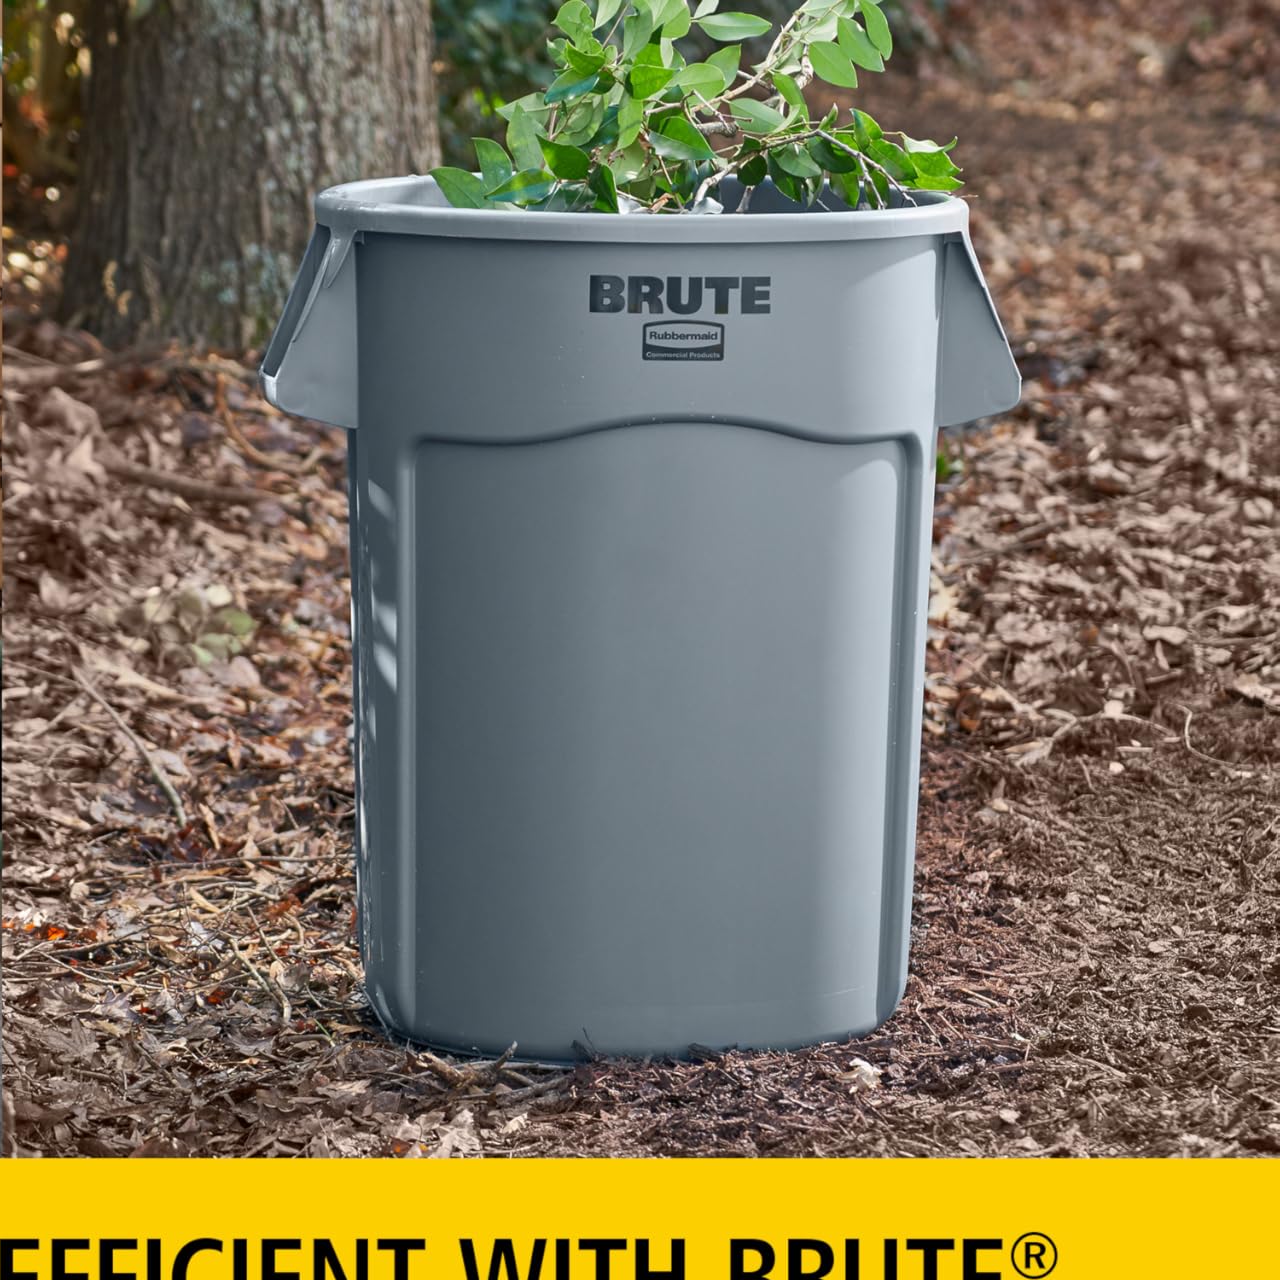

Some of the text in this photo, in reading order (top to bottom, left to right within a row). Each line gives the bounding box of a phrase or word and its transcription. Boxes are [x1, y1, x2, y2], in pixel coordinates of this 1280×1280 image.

[589, 274, 771, 315] BRUTE
[649, 331, 718, 341] Rubbermaid
[646, 351, 720, 359] Commercial Products
